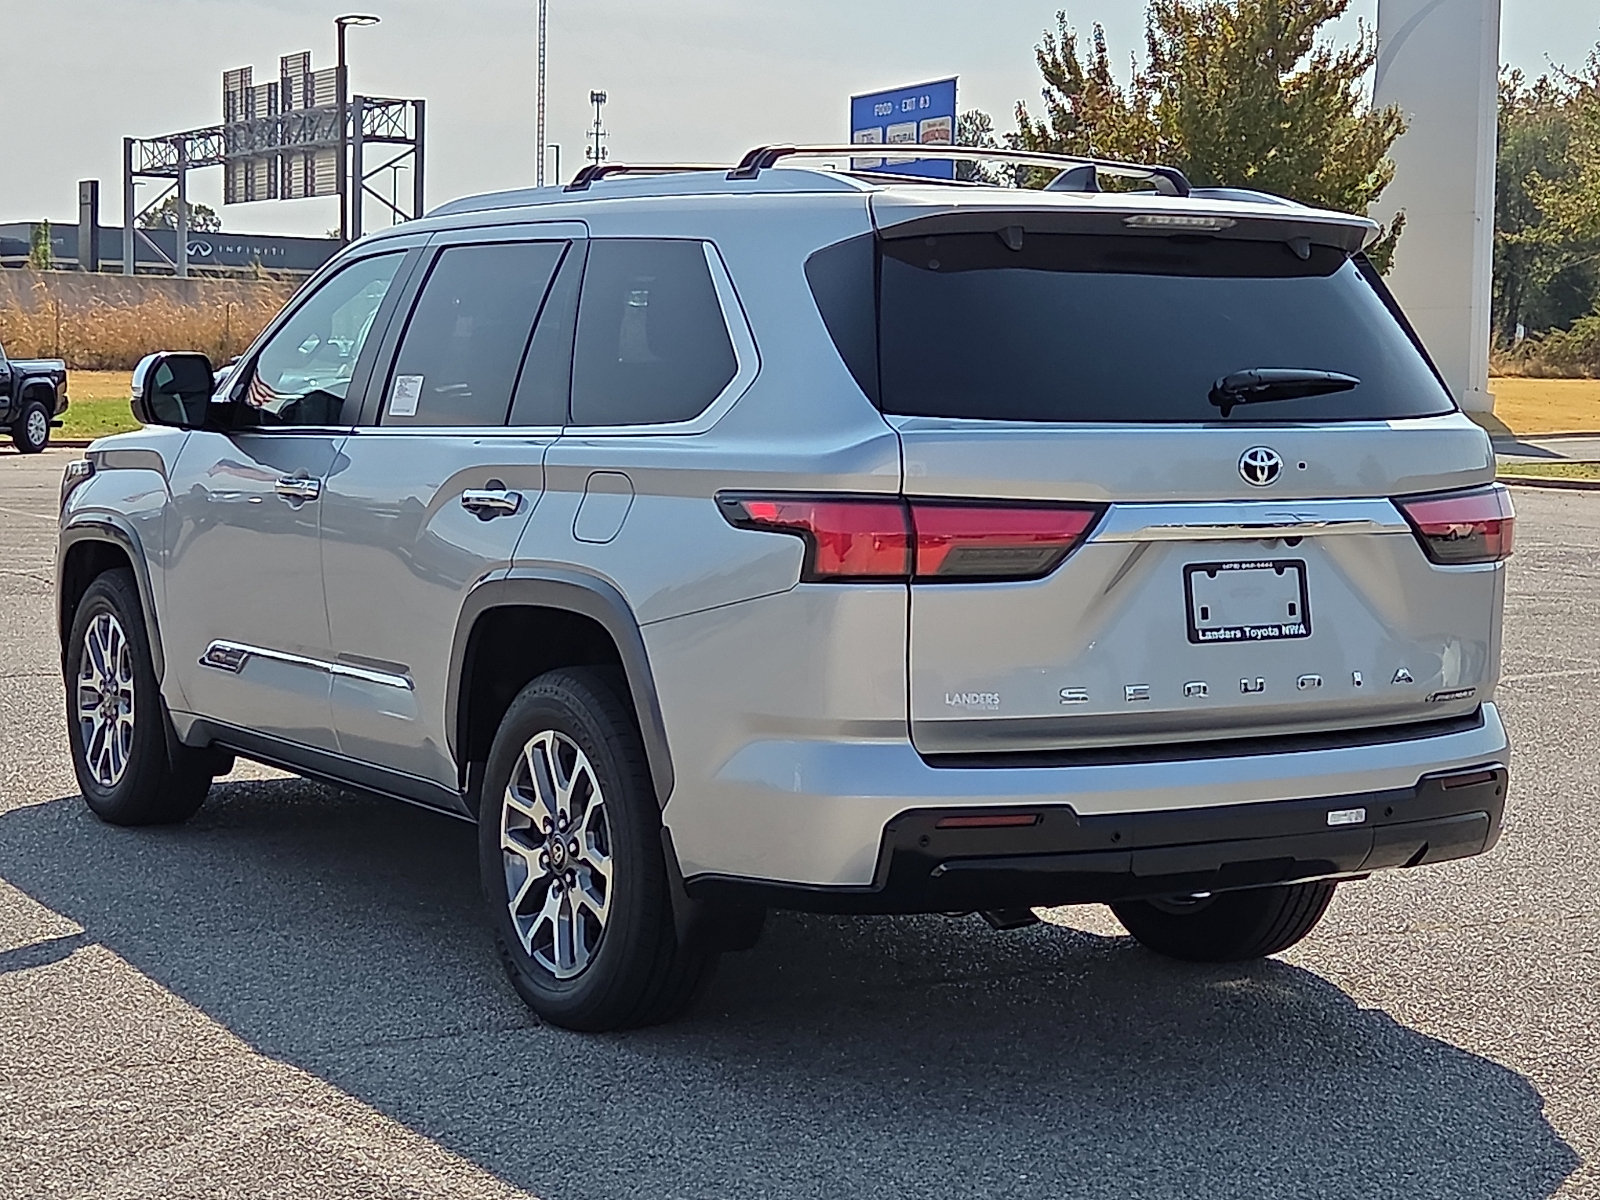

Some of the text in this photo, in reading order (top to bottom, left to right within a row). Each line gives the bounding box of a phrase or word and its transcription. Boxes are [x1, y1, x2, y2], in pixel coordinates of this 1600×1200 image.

[874, 102, 892, 116] FOOD
[902, 98, 916, 112] EXIT
[218, 245, 285, 256] INFINITI
[1198, 623, 1307, 641] Landers Toyota NWA
[1059, 667, 1414, 706] SEQUOIA
[945, 692, 1000, 706] LANDERS
